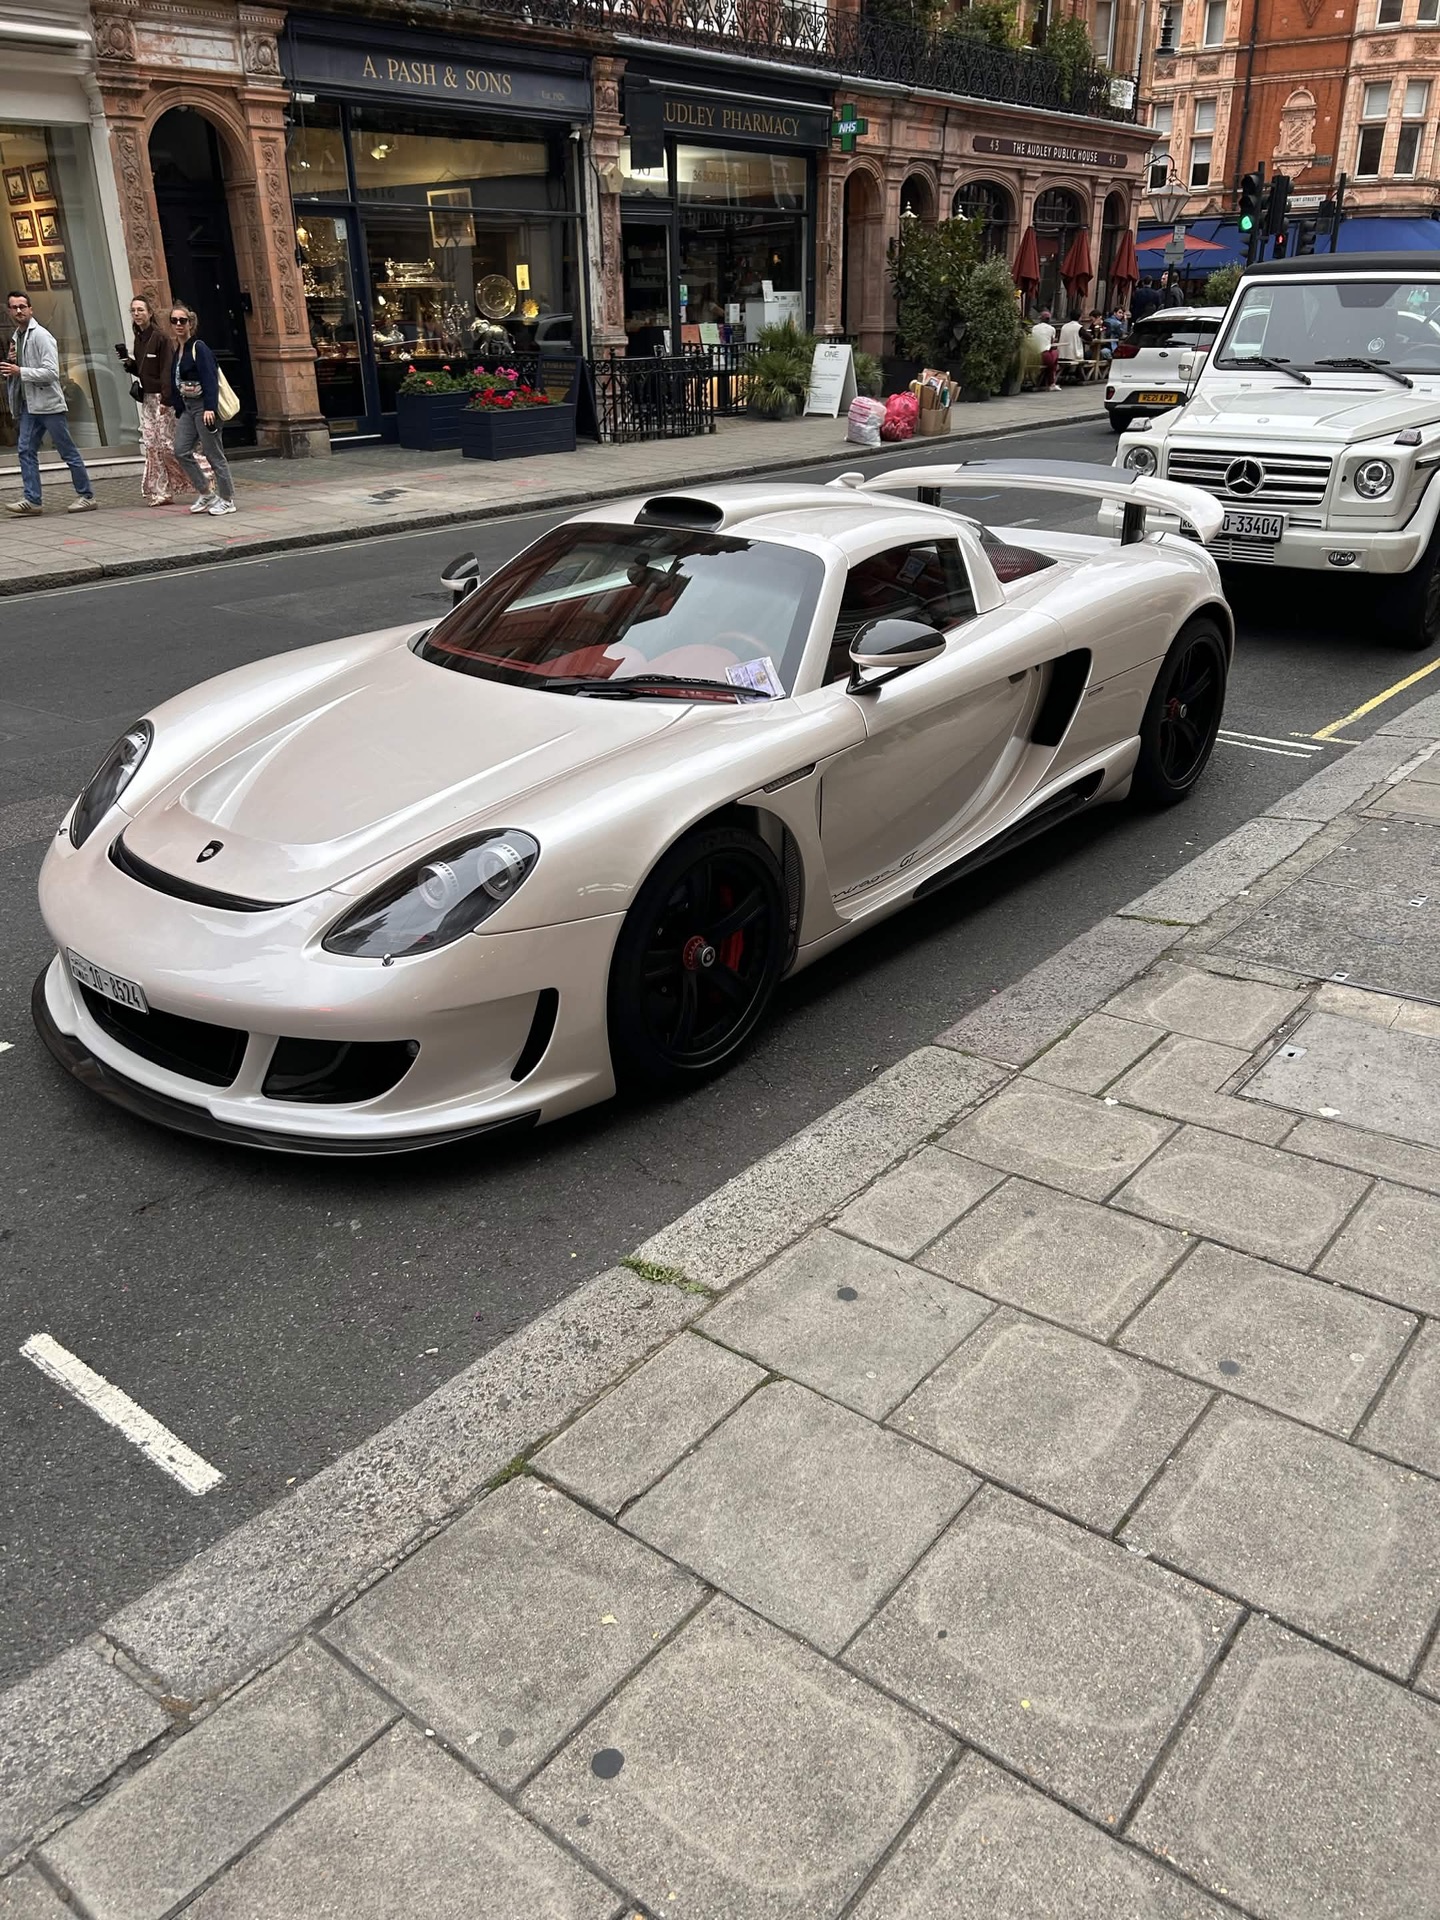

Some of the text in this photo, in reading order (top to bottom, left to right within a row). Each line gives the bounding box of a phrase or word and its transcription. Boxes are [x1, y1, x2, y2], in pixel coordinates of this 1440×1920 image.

[362, 55, 383, 79] A.
[387, 58, 437, 86] PASH
[443, 66, 458, 89] &
[466, 69, 512, 96] SONS
[663, 102, 800, 137] UDLEY PHARMACY
[838, 121, 857, 134] NHS
[990, 139, 1117, 164] 43 THE AUDLEY PUBLIC HOUSE 43
[824, 350, 840, 358] ONE
[900, 850, 919, 868] GT
[89, 966, 141, 1008] 10-8524
